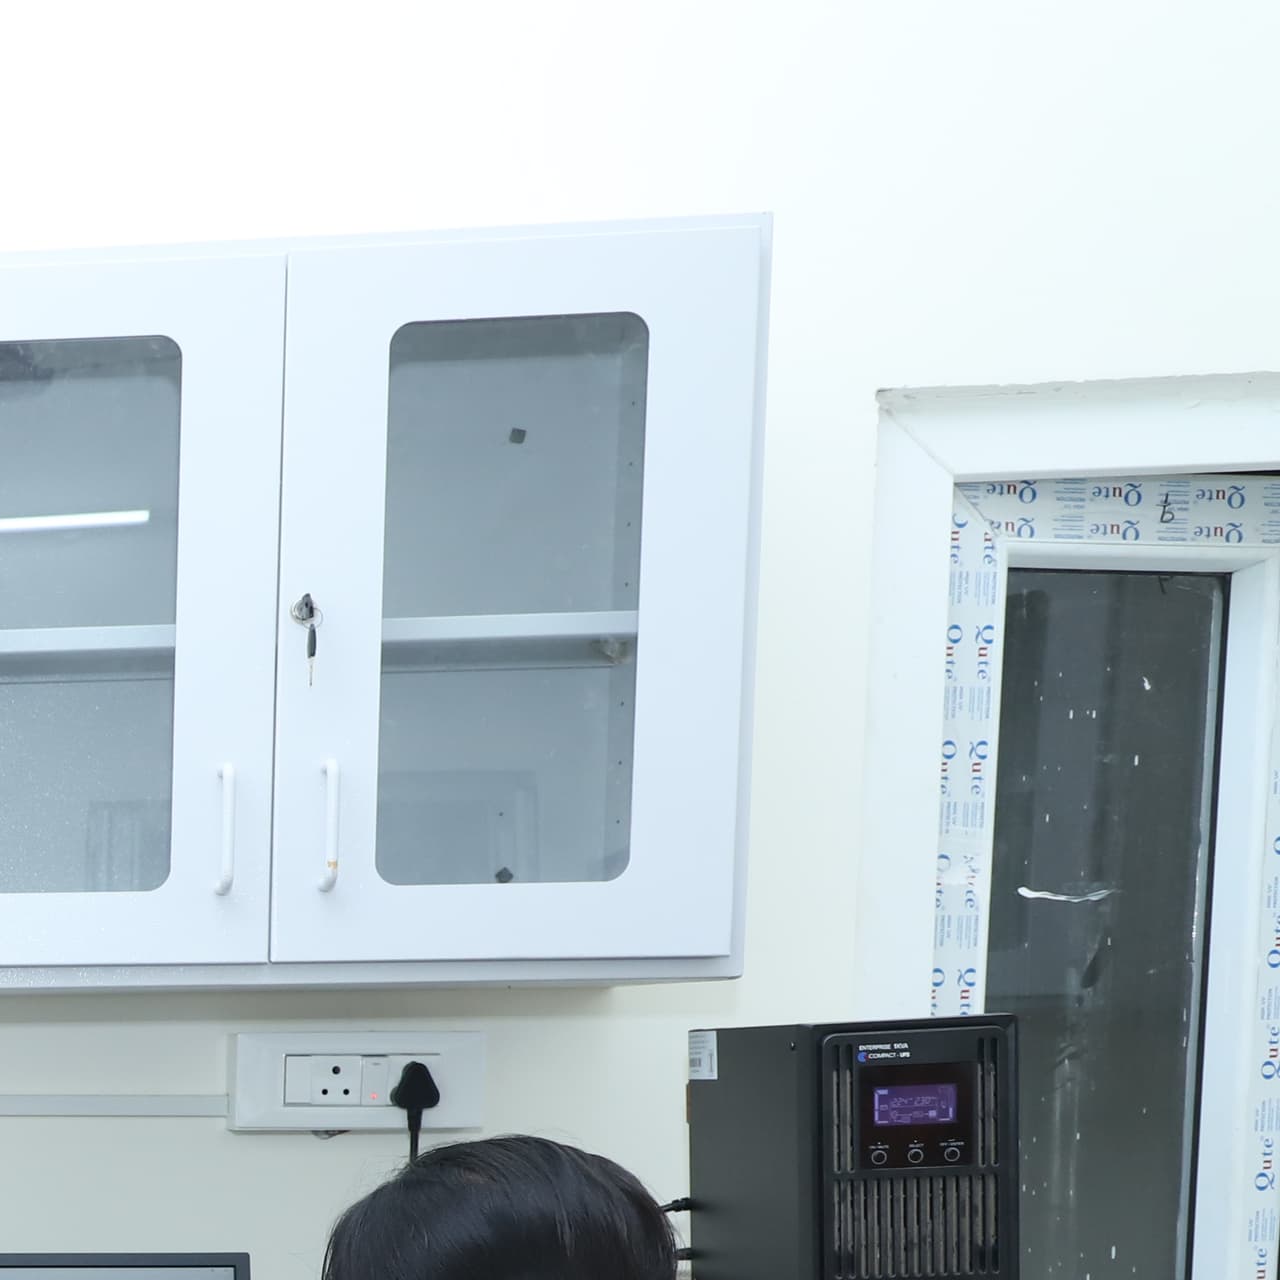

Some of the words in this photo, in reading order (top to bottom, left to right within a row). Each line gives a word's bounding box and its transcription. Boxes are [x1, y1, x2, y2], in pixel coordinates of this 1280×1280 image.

[986, 480, 1037, 504] Qute
[1092, 483, 1142, 506] Qute
[1195, 486, 1246, 509] Qute
[975, 624, 994, 680] Qute
[969, 740, 988, 795] Qute
[1254, 1138, 1275, 1191] Qute
